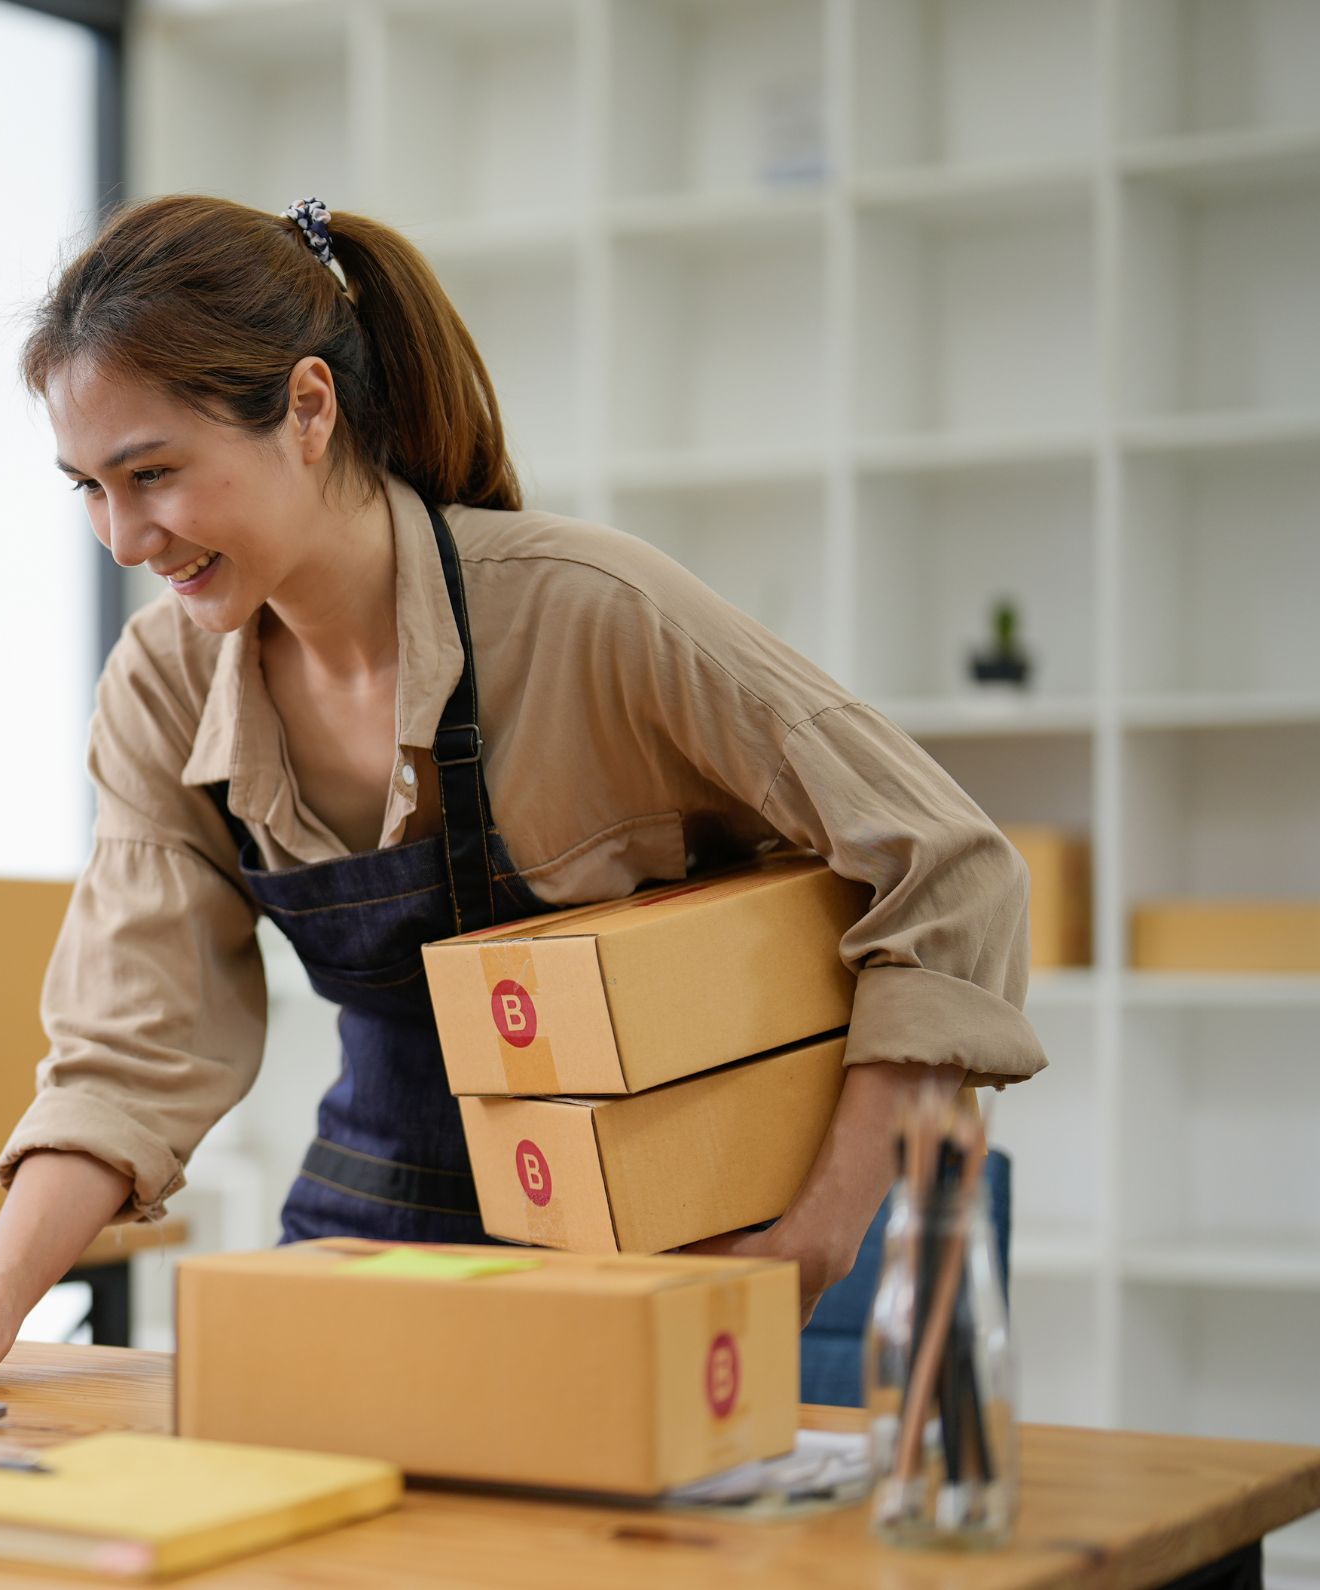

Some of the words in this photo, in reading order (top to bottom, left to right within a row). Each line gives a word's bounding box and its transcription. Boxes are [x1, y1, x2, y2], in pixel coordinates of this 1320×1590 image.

[500, 994, 527, 1032] B
[522, 1152, 544, 1191] B
[711, 1347, 735, 1401] B
